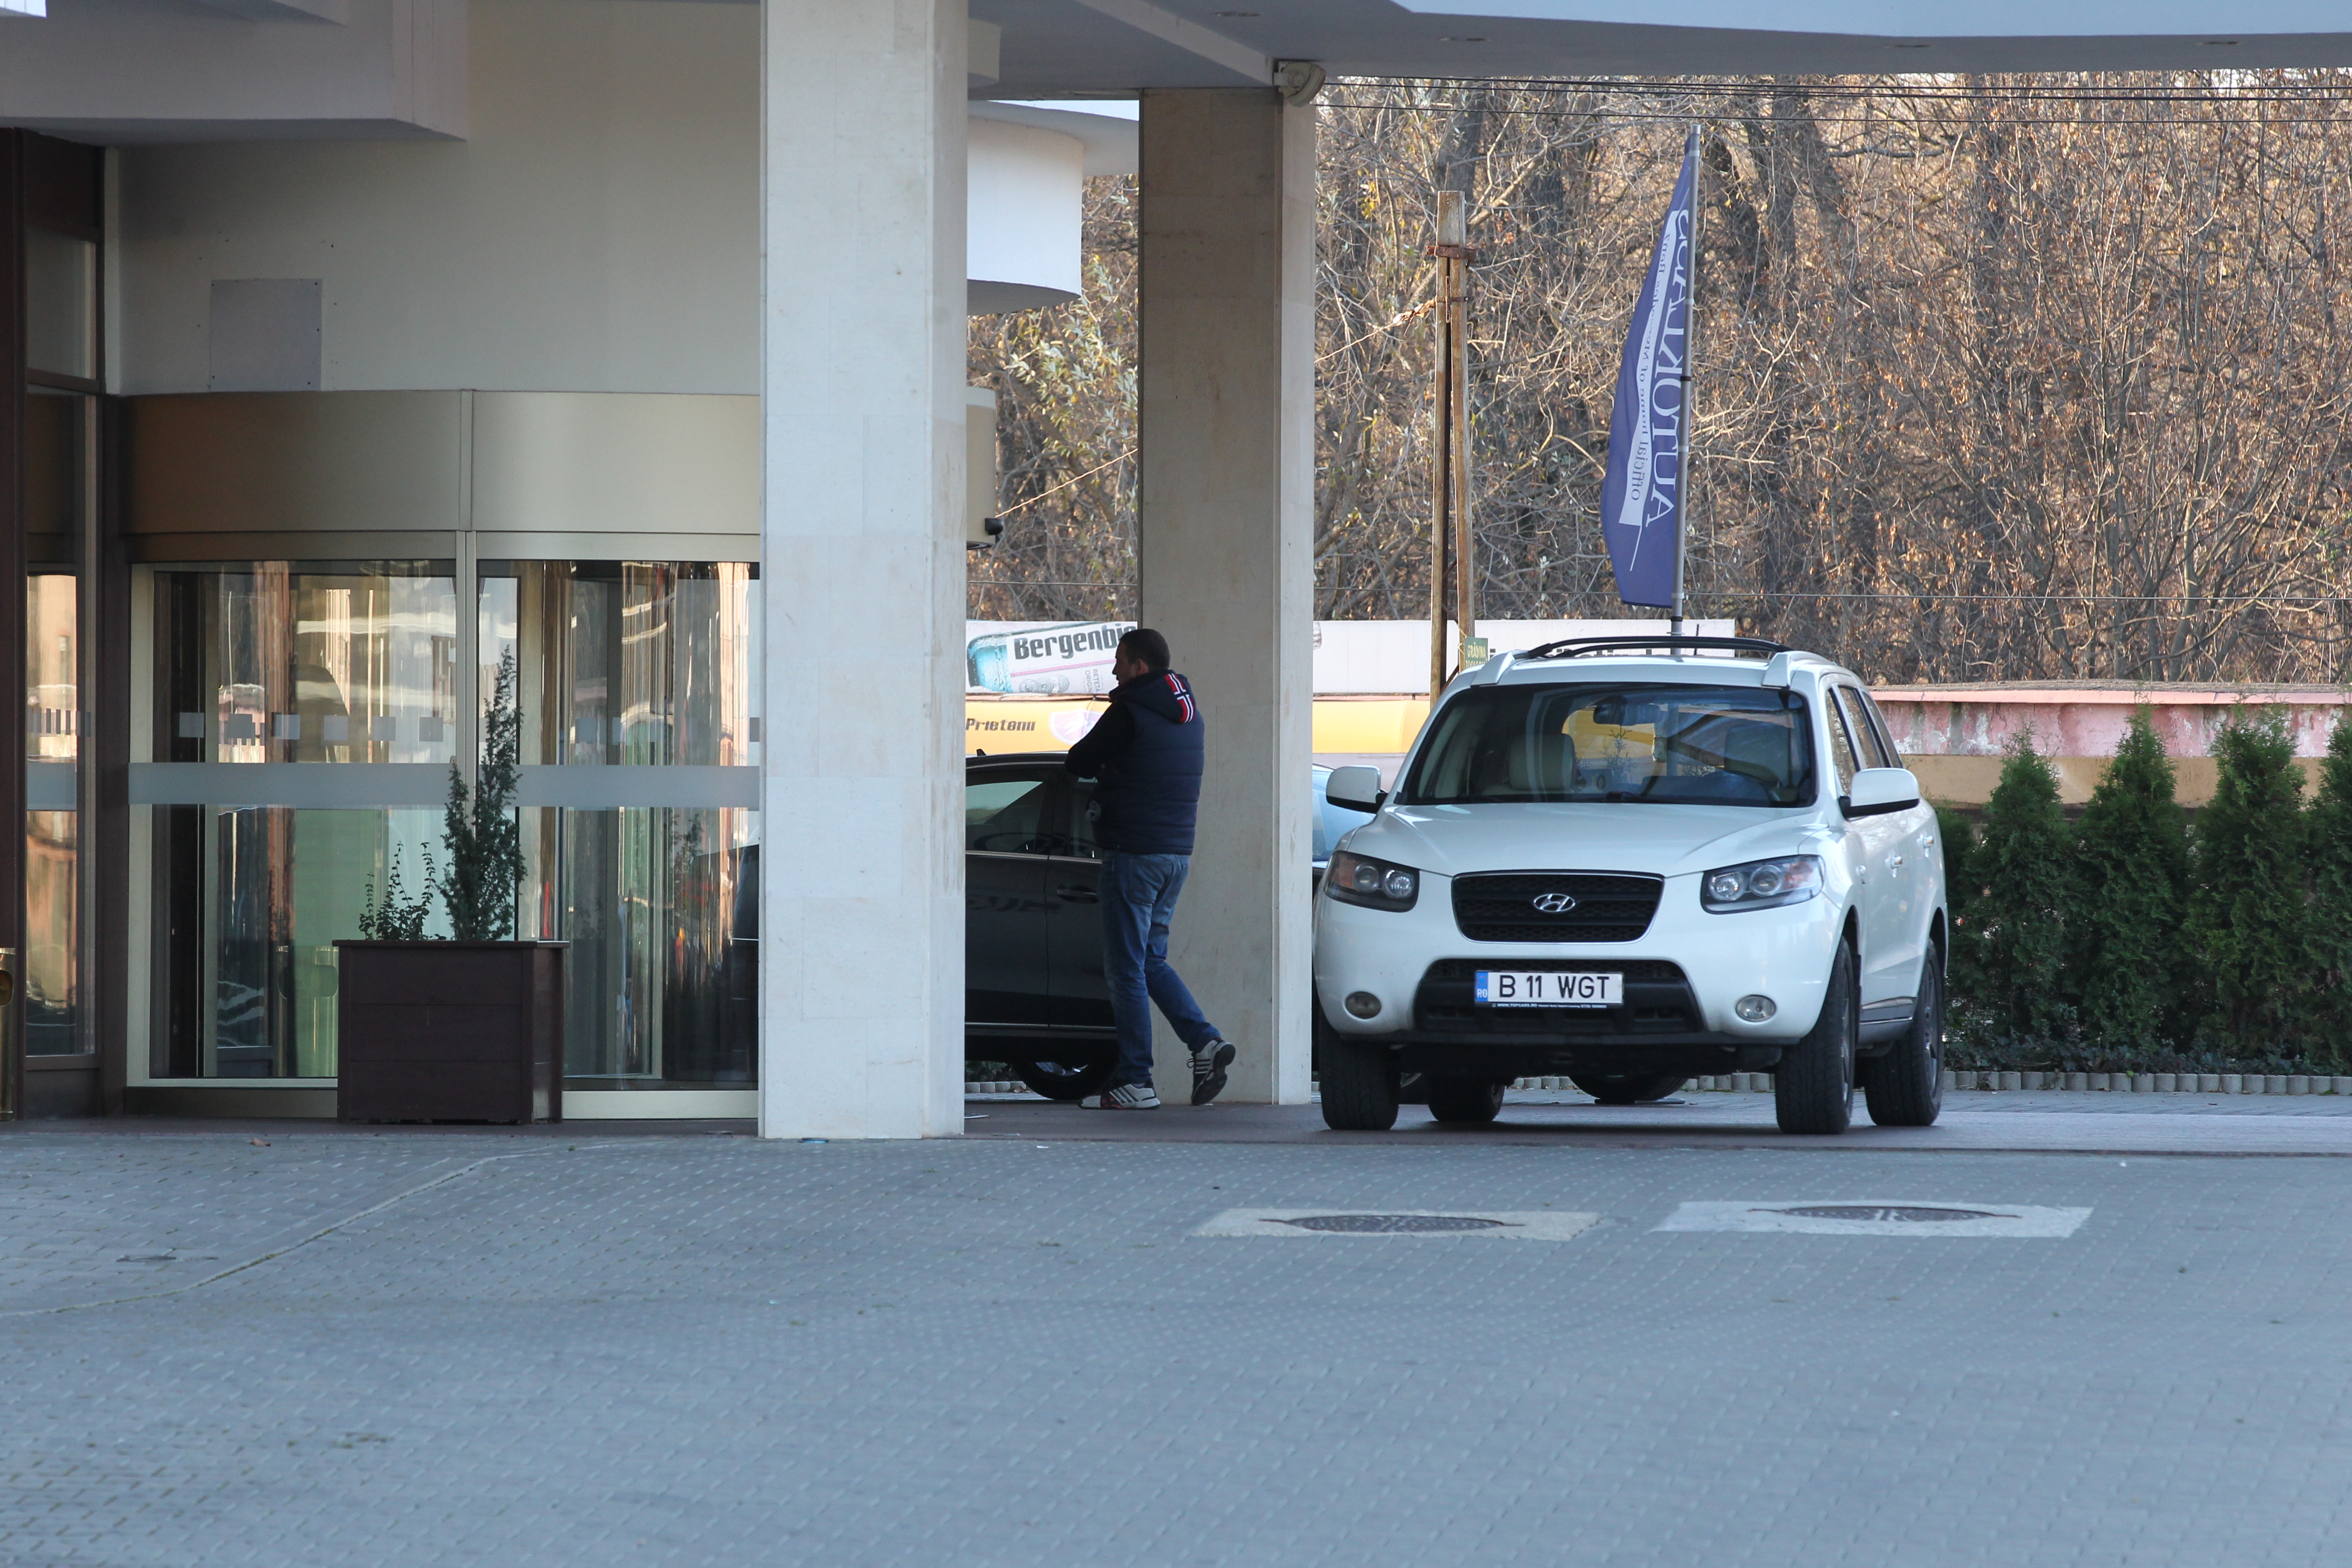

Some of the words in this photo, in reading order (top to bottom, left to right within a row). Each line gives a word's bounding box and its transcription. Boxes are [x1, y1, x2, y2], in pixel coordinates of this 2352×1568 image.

[1477, 988, 1487, 998] RO
[1499, 975, 1516, 998] B
[1526, 975, 1543, 998] 11
[1557, 975, 1610, 999] WGT
